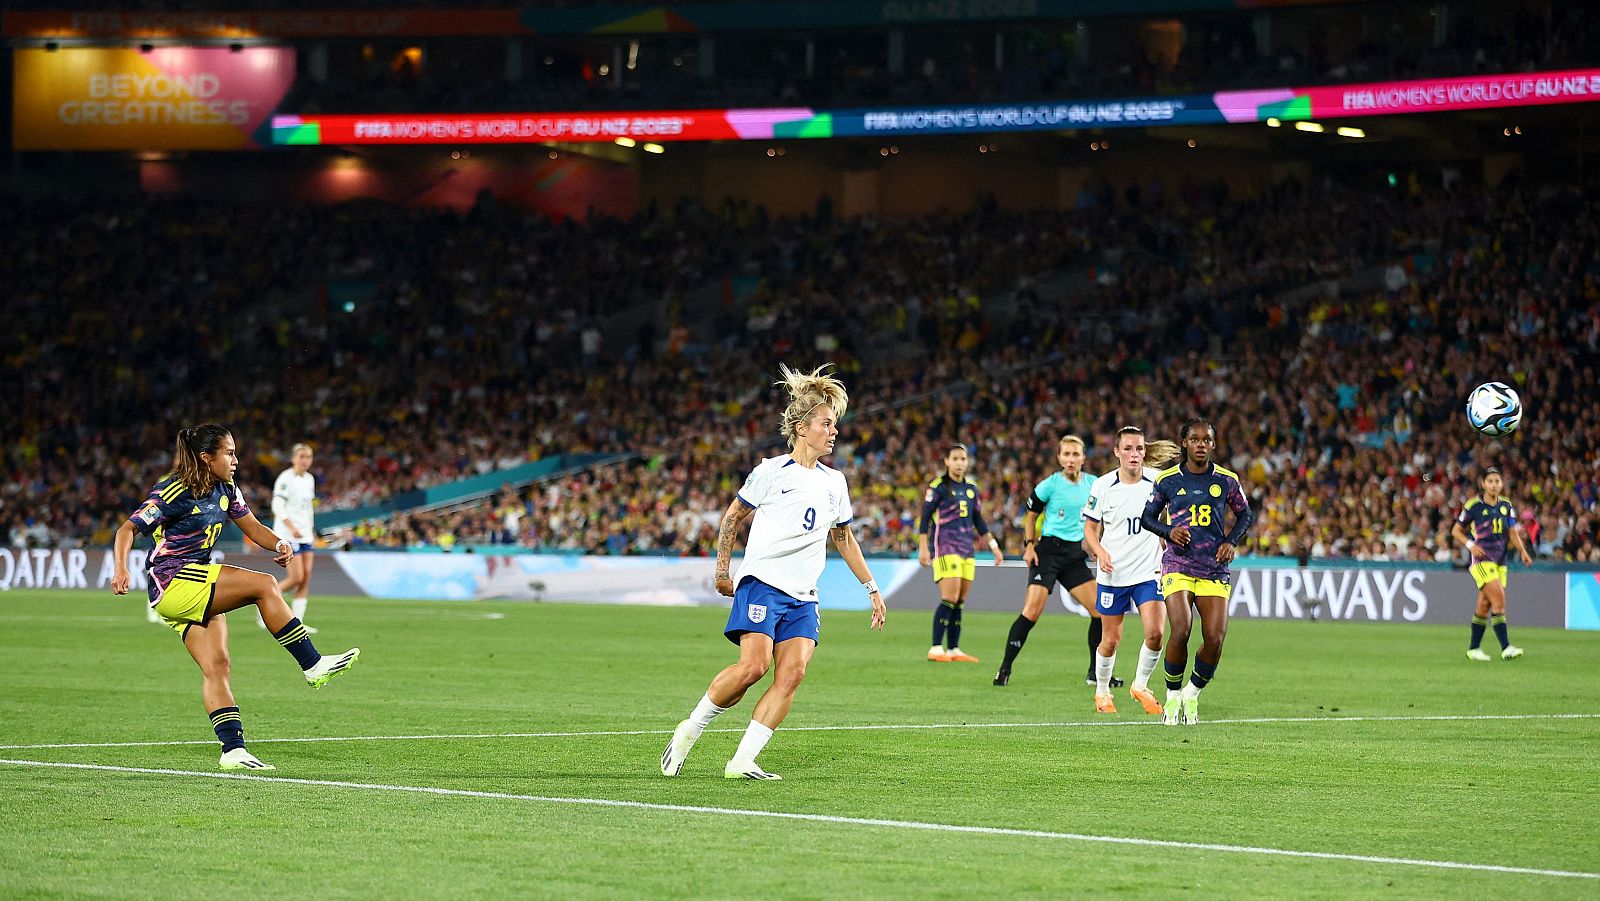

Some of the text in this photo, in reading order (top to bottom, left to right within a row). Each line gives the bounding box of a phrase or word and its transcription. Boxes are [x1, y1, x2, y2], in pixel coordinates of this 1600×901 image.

[88, 73, 220, 99] BEYOND
[1343, 91, 1376, 110] FIFA
[1376, 85, 1446, 107] WOMEN'S
[1447, 82, 1501, 103] WORLD
[1503, 79, 1535, 100] CUP
[58, 100, 249, 125] GREATNESS
[864, 112, 899, 130] FIFA
[899, 109, 977, 129] WOMEN'S
[978, 106, 1035, 127] WORLD
[1035, 105, 1067, 124] CUP
[354, 121, 392, 138] FIFA
[394, 120, 475, 138] WOMEN'S
[477, 119, 536, 137] WORLD
[536, 119, 570, 136] CUP
[802, 507, 816, 531] 9
[959, 499, 969, 518] 5
[1188, 504, 1212, 527] 18
[200, 522, 223, 549] 10
[1126, 516, 1142, 535] 10
[1492, 517, 1503, 534] 11
[1228, 567, 1428, 622] AIRWAYS
